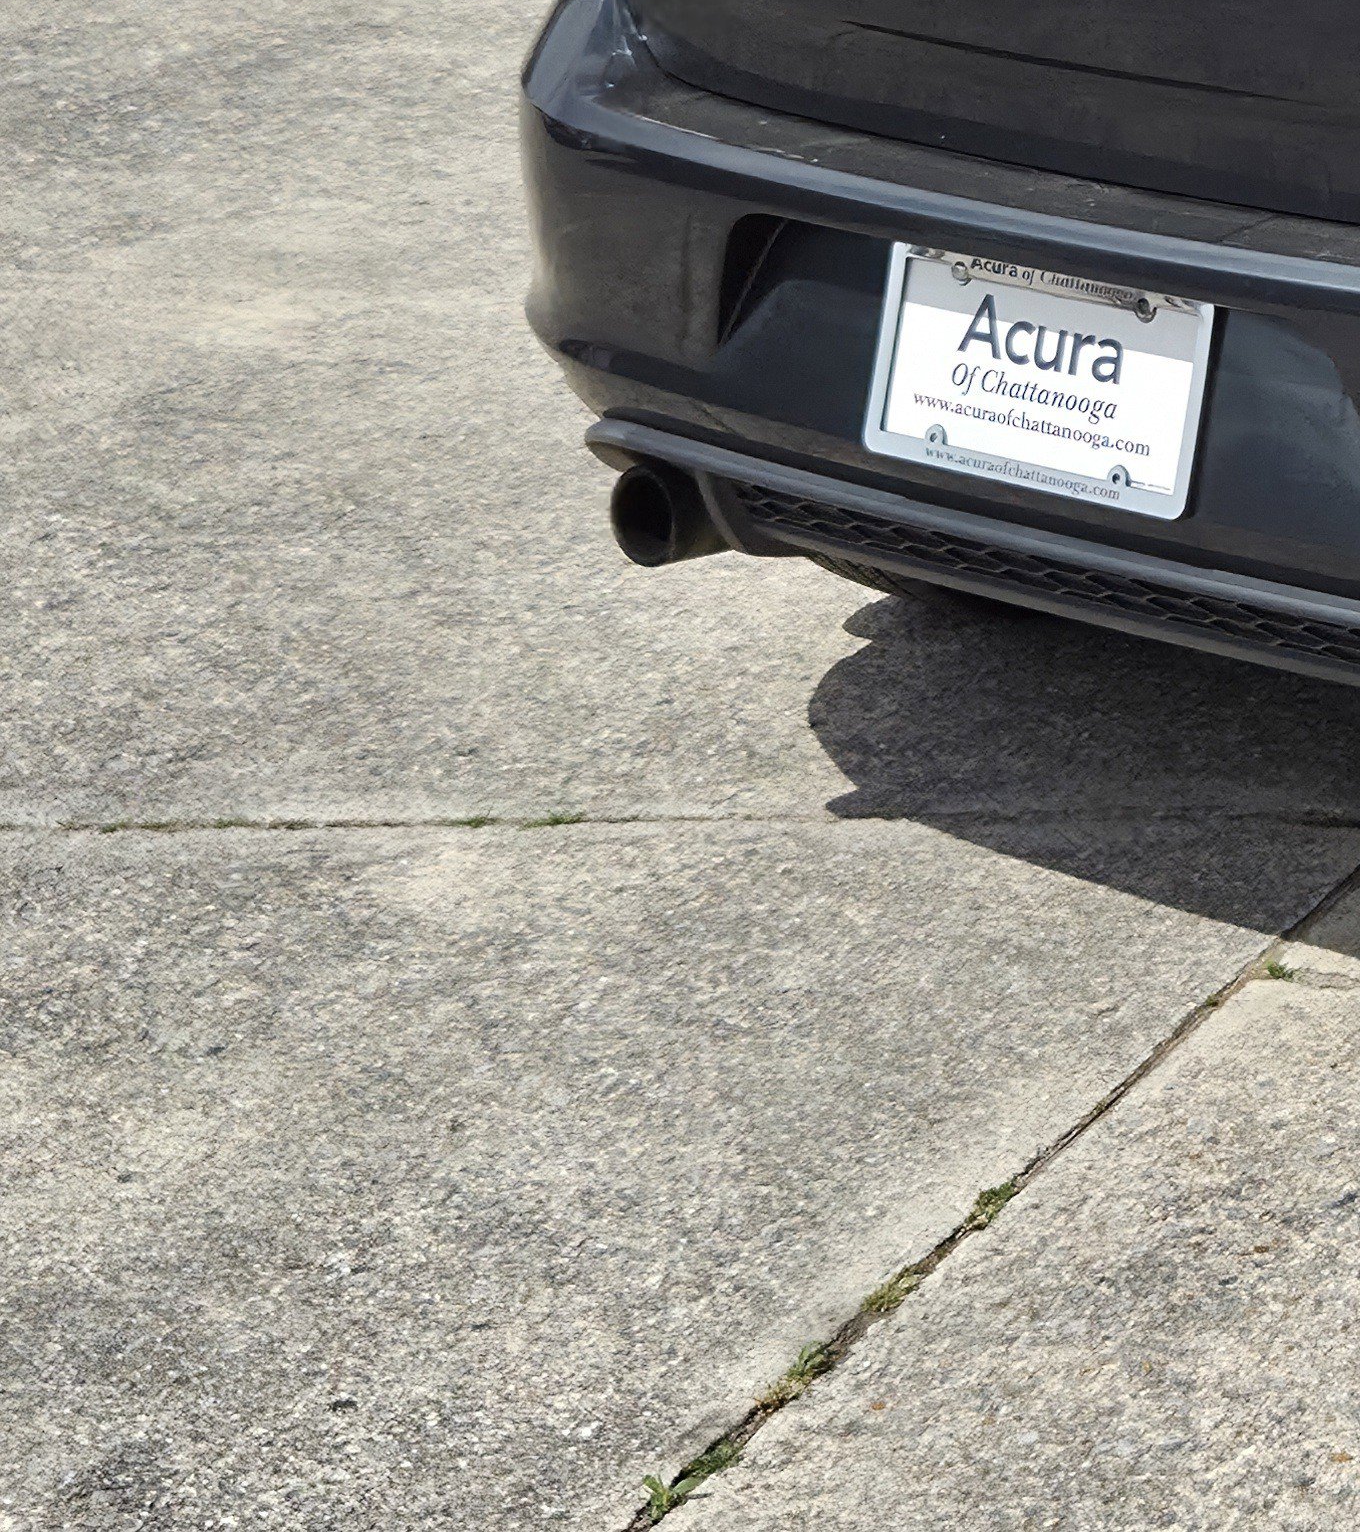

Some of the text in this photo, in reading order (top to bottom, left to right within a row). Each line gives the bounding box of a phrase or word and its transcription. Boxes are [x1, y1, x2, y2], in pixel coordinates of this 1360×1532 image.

[970, 257, 1018, 278] Acura
[1022, 267, 1036, 285] of
[957, 294, 1124, 385] Acura
[952, 363, 1118, 424] Of Chattanooga
[913, 392, 1150, 457] www.acuraofchattanooga.com
[926, 446, 1120, 501] www.acuraofchattanooga.com
